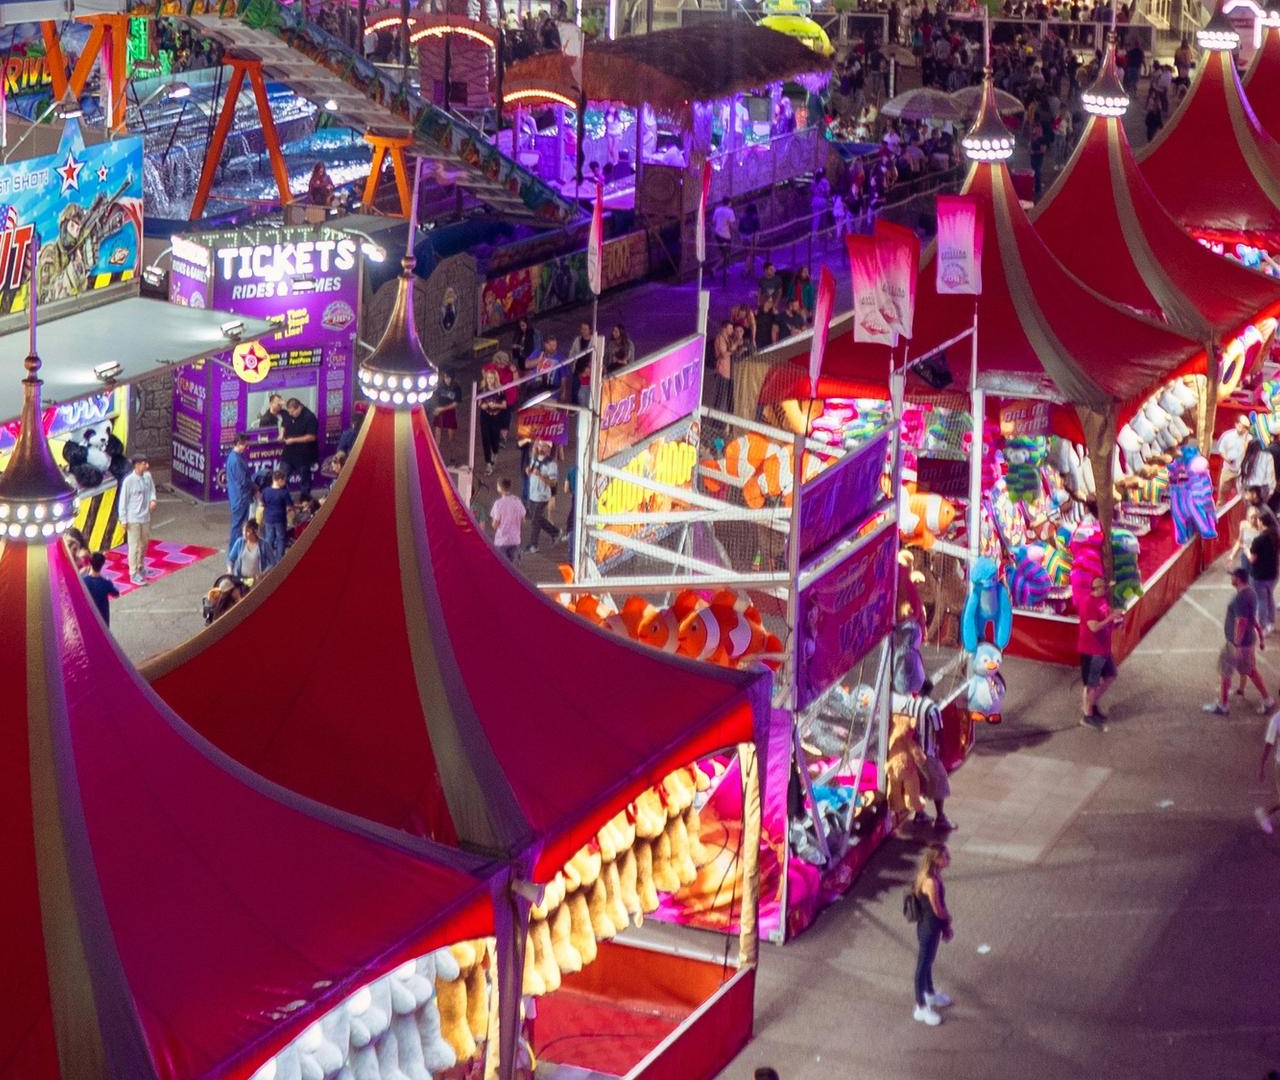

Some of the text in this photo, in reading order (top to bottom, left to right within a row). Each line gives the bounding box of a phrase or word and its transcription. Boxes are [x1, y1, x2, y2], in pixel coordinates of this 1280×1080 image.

[13, 170, 49, 193] SHOT!
[217, 240, 357, 281] TICKETS
[232, 281, 275, 300] RIDES
[277, 281, 289, 297] &
[172, 441, 205, 471] TICKETS
